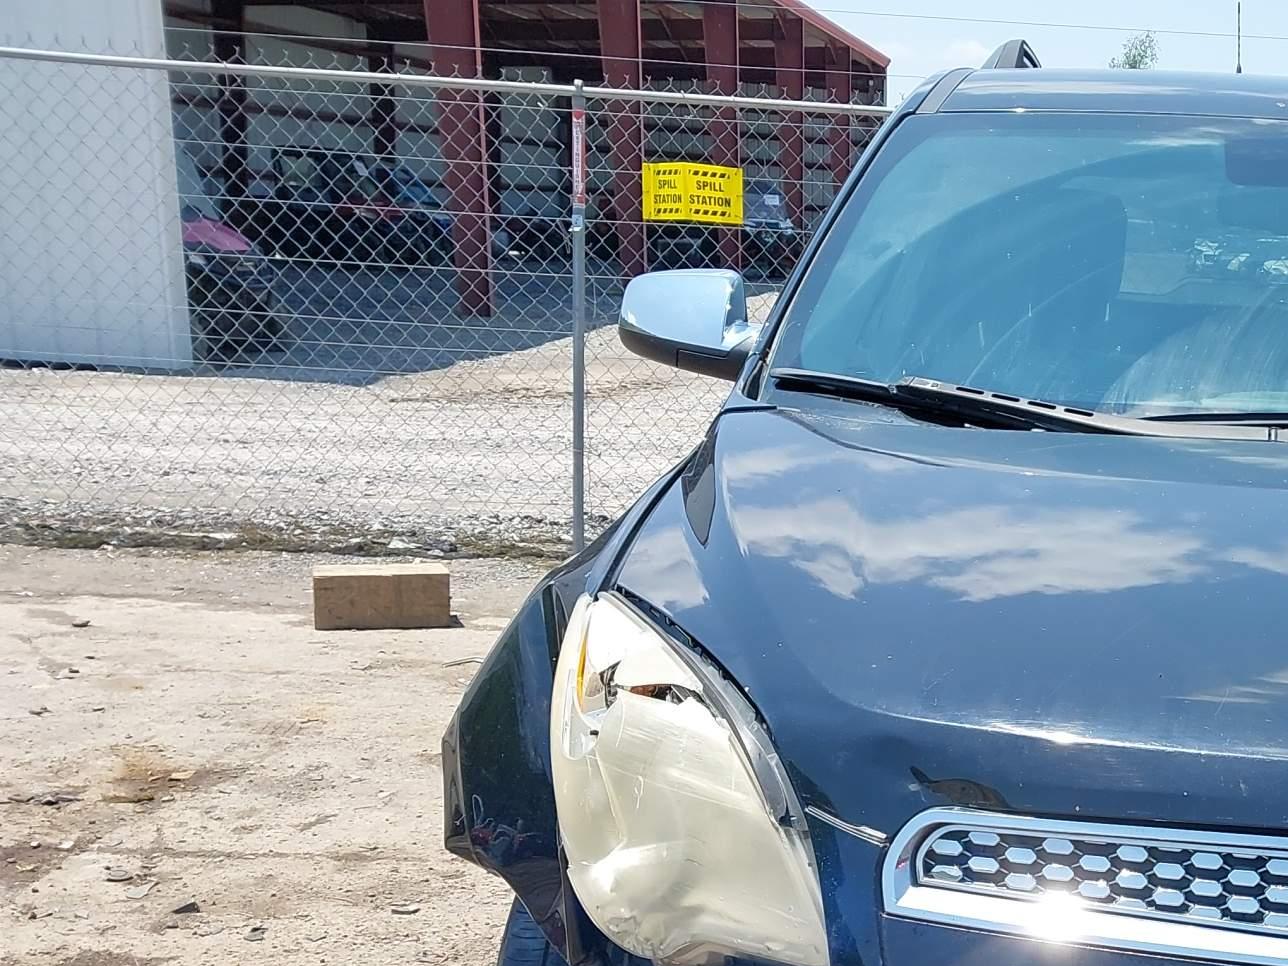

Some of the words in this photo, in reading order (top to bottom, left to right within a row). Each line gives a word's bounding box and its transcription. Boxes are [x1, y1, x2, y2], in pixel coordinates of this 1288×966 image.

[658, 179, 677, 190] SPILL
[696, 180, 725, 193] SPILL
[653, 194, 682, 204] STATION
[689, 195, 731, 208] STATION
